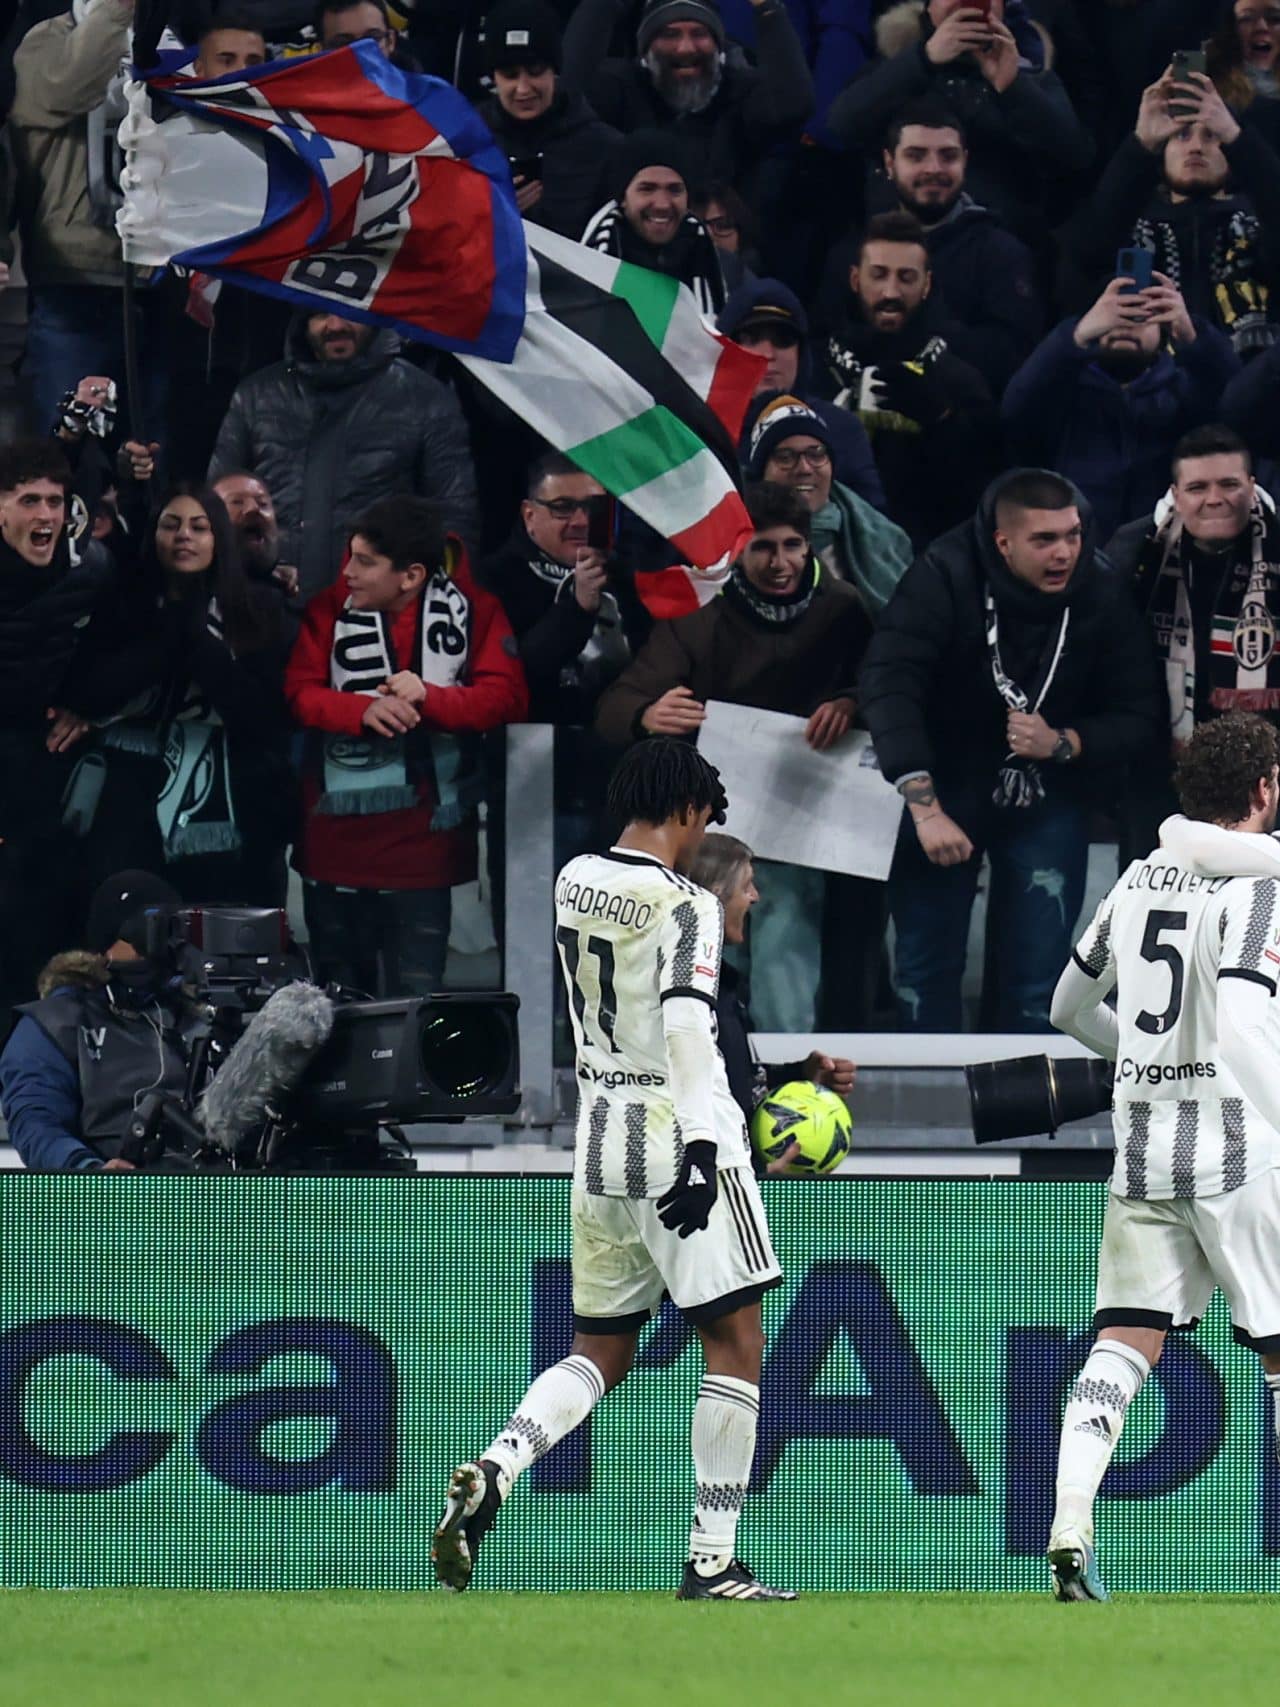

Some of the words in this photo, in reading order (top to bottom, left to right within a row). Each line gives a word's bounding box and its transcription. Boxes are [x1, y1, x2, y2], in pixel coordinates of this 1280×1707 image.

[556, 923, 623, 1054] 11
[1134, 909, 1188, 1035] 5
[1119, 1057, 1217, 1085] Cygames
[0, 1313, 398, 1496] ca
